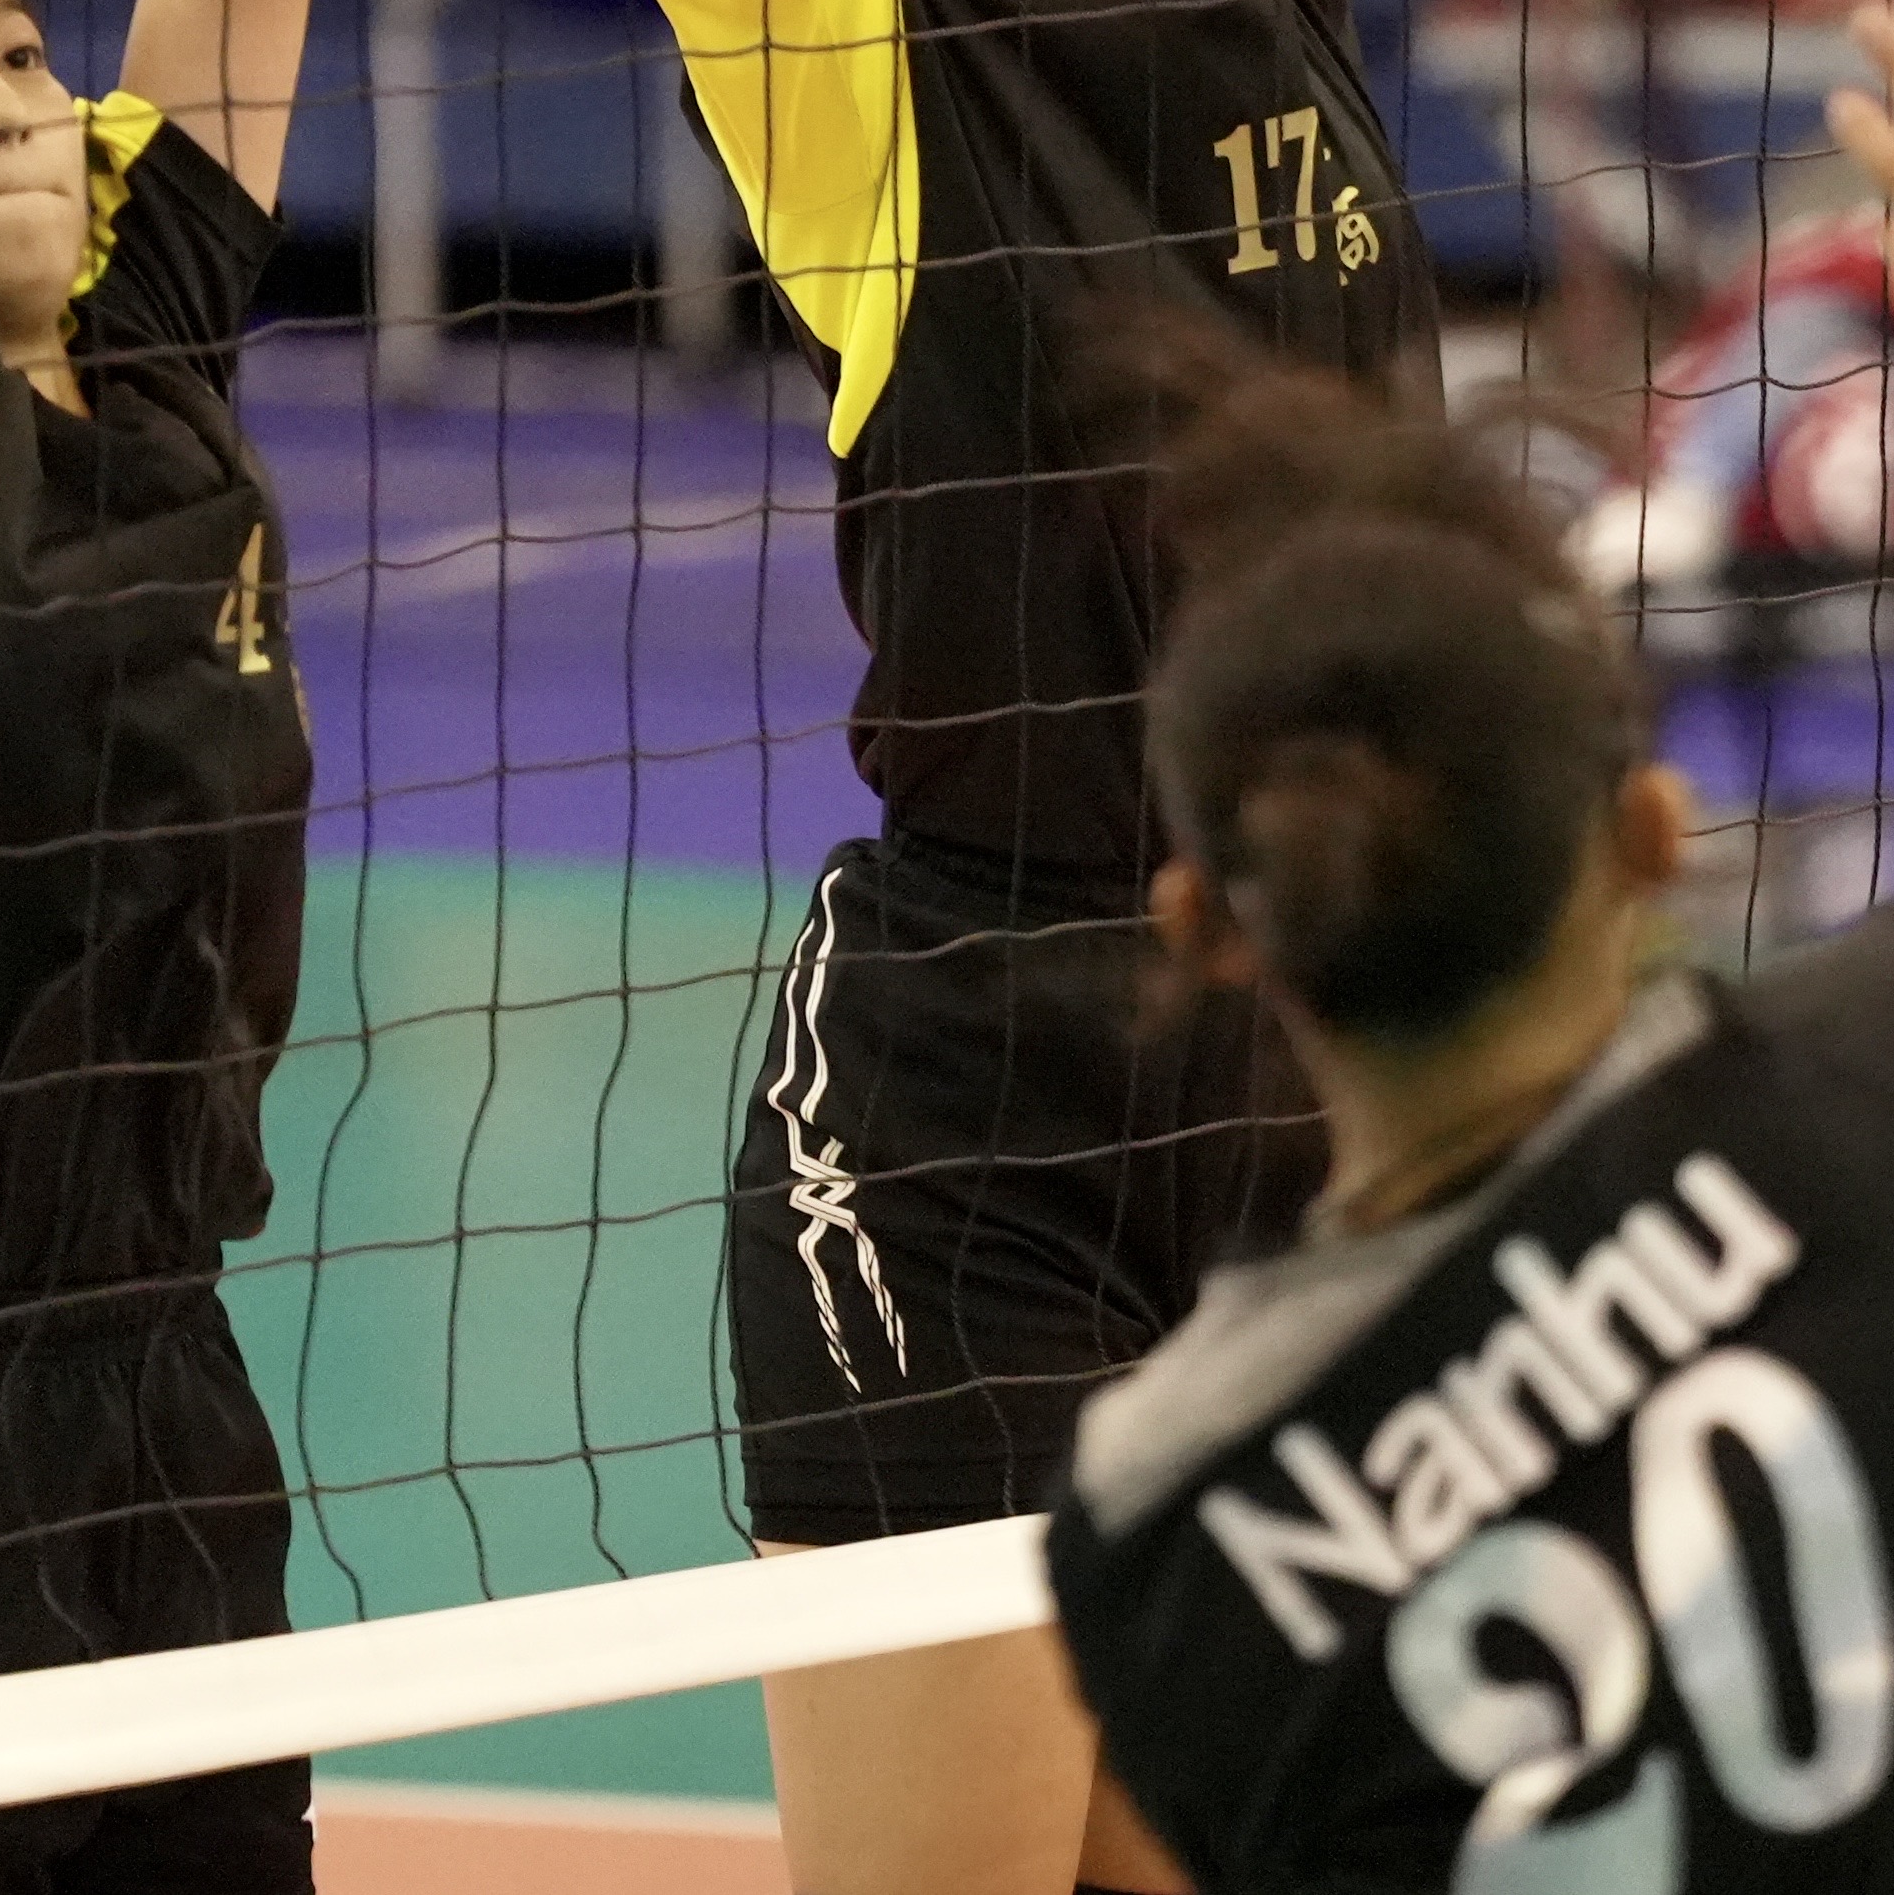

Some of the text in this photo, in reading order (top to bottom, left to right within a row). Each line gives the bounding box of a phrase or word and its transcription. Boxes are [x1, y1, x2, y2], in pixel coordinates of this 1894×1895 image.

[1213, 106, 1318, 275] 17
[215, 522, 271, 674] 4
[1199, 1151, 1802, 1662] Nanhu
